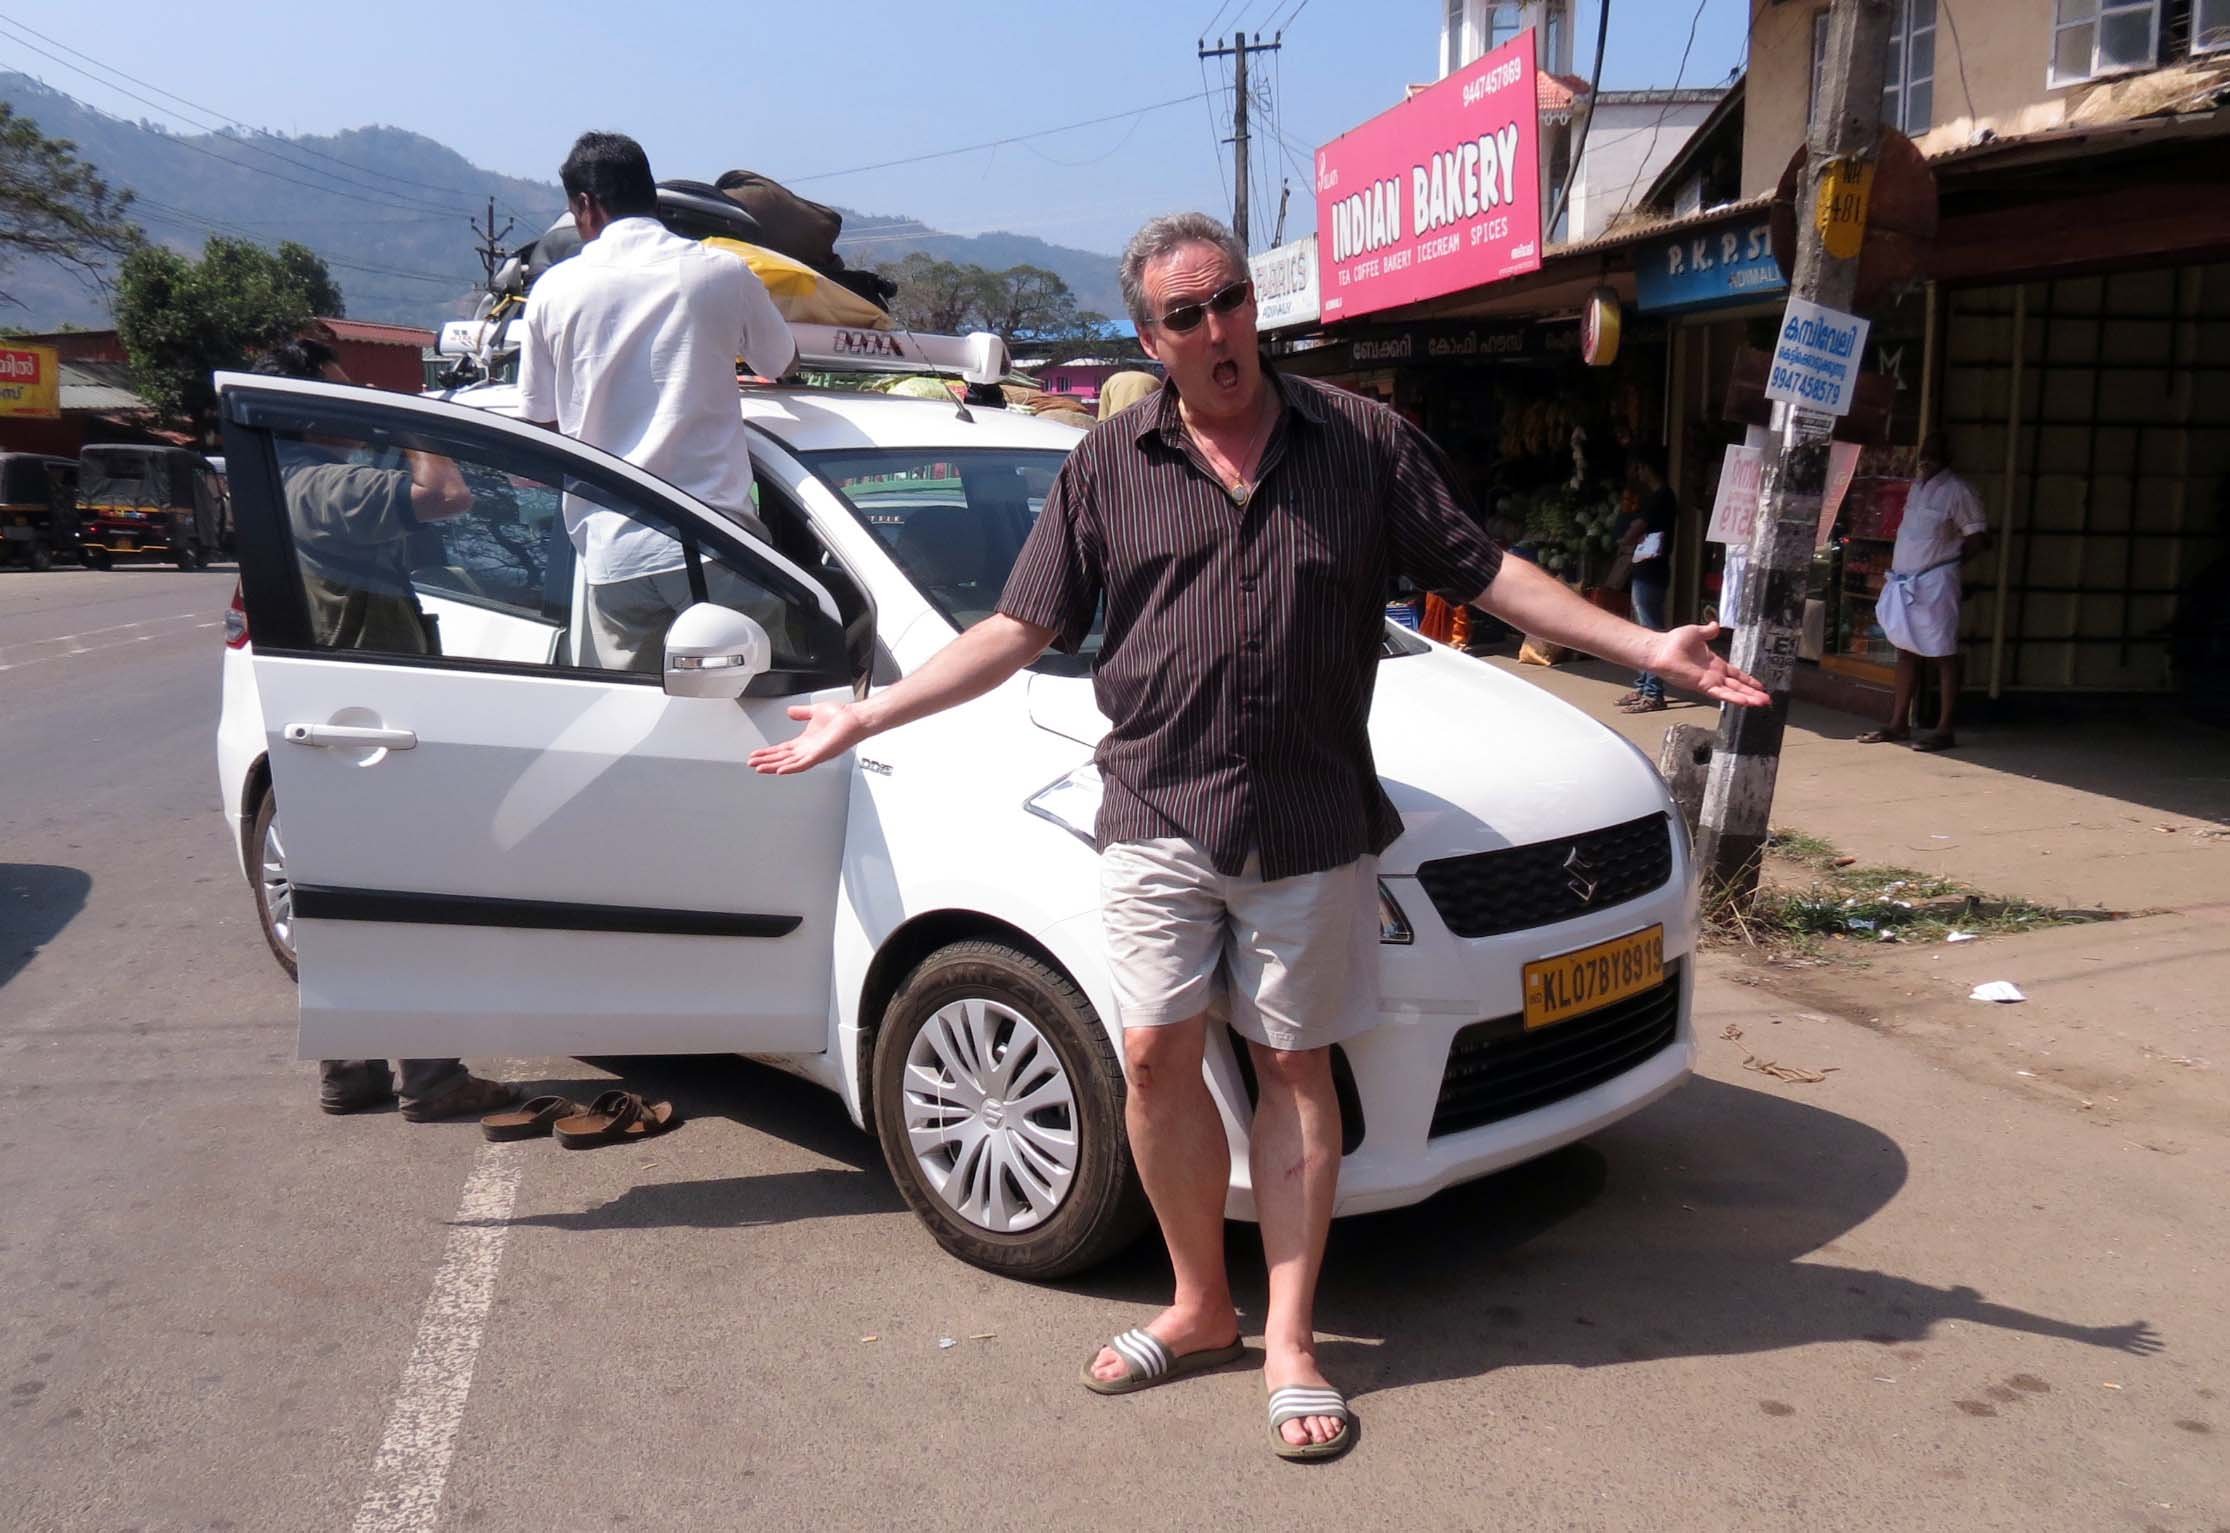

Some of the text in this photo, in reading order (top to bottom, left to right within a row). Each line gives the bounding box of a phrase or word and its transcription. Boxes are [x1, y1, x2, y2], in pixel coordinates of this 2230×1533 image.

[1463, 56, 1522, 108] 9447457869
[1332, 121, 1518, 264] INDIAN BAKERY
[1338, 216, 1509, 286] TEA COFFEE BAKERY ICECREAM SPICES
[1771, 367, 1841, 405] 9947458579
[1543, 936, 1663, 1013] KL07BY8919
